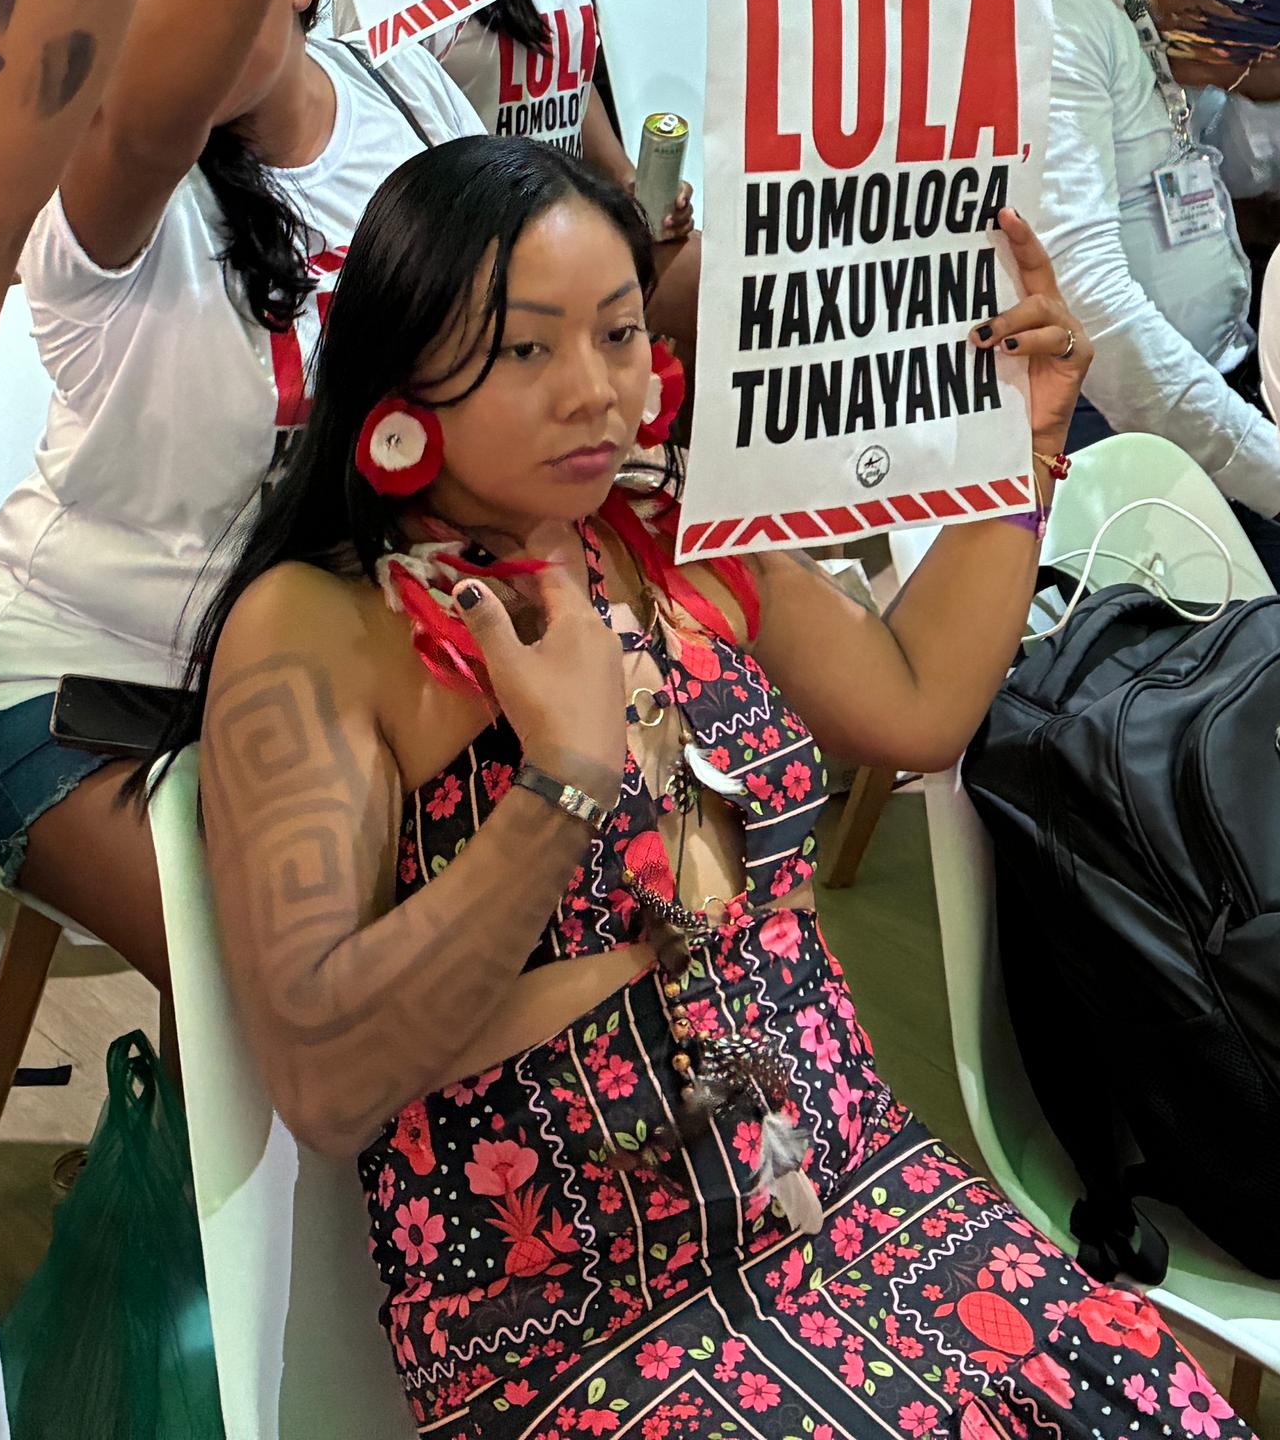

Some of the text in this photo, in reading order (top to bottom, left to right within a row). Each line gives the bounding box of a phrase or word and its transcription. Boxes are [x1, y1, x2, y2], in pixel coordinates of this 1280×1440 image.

[496, 86, 585, 137] HOMOLO
[745, 165, 1009, 257] HOMOLOGA
[738, 248, 998, 351] KAXUYANA
[731, 339, 1002, 448] TUNAYANA
